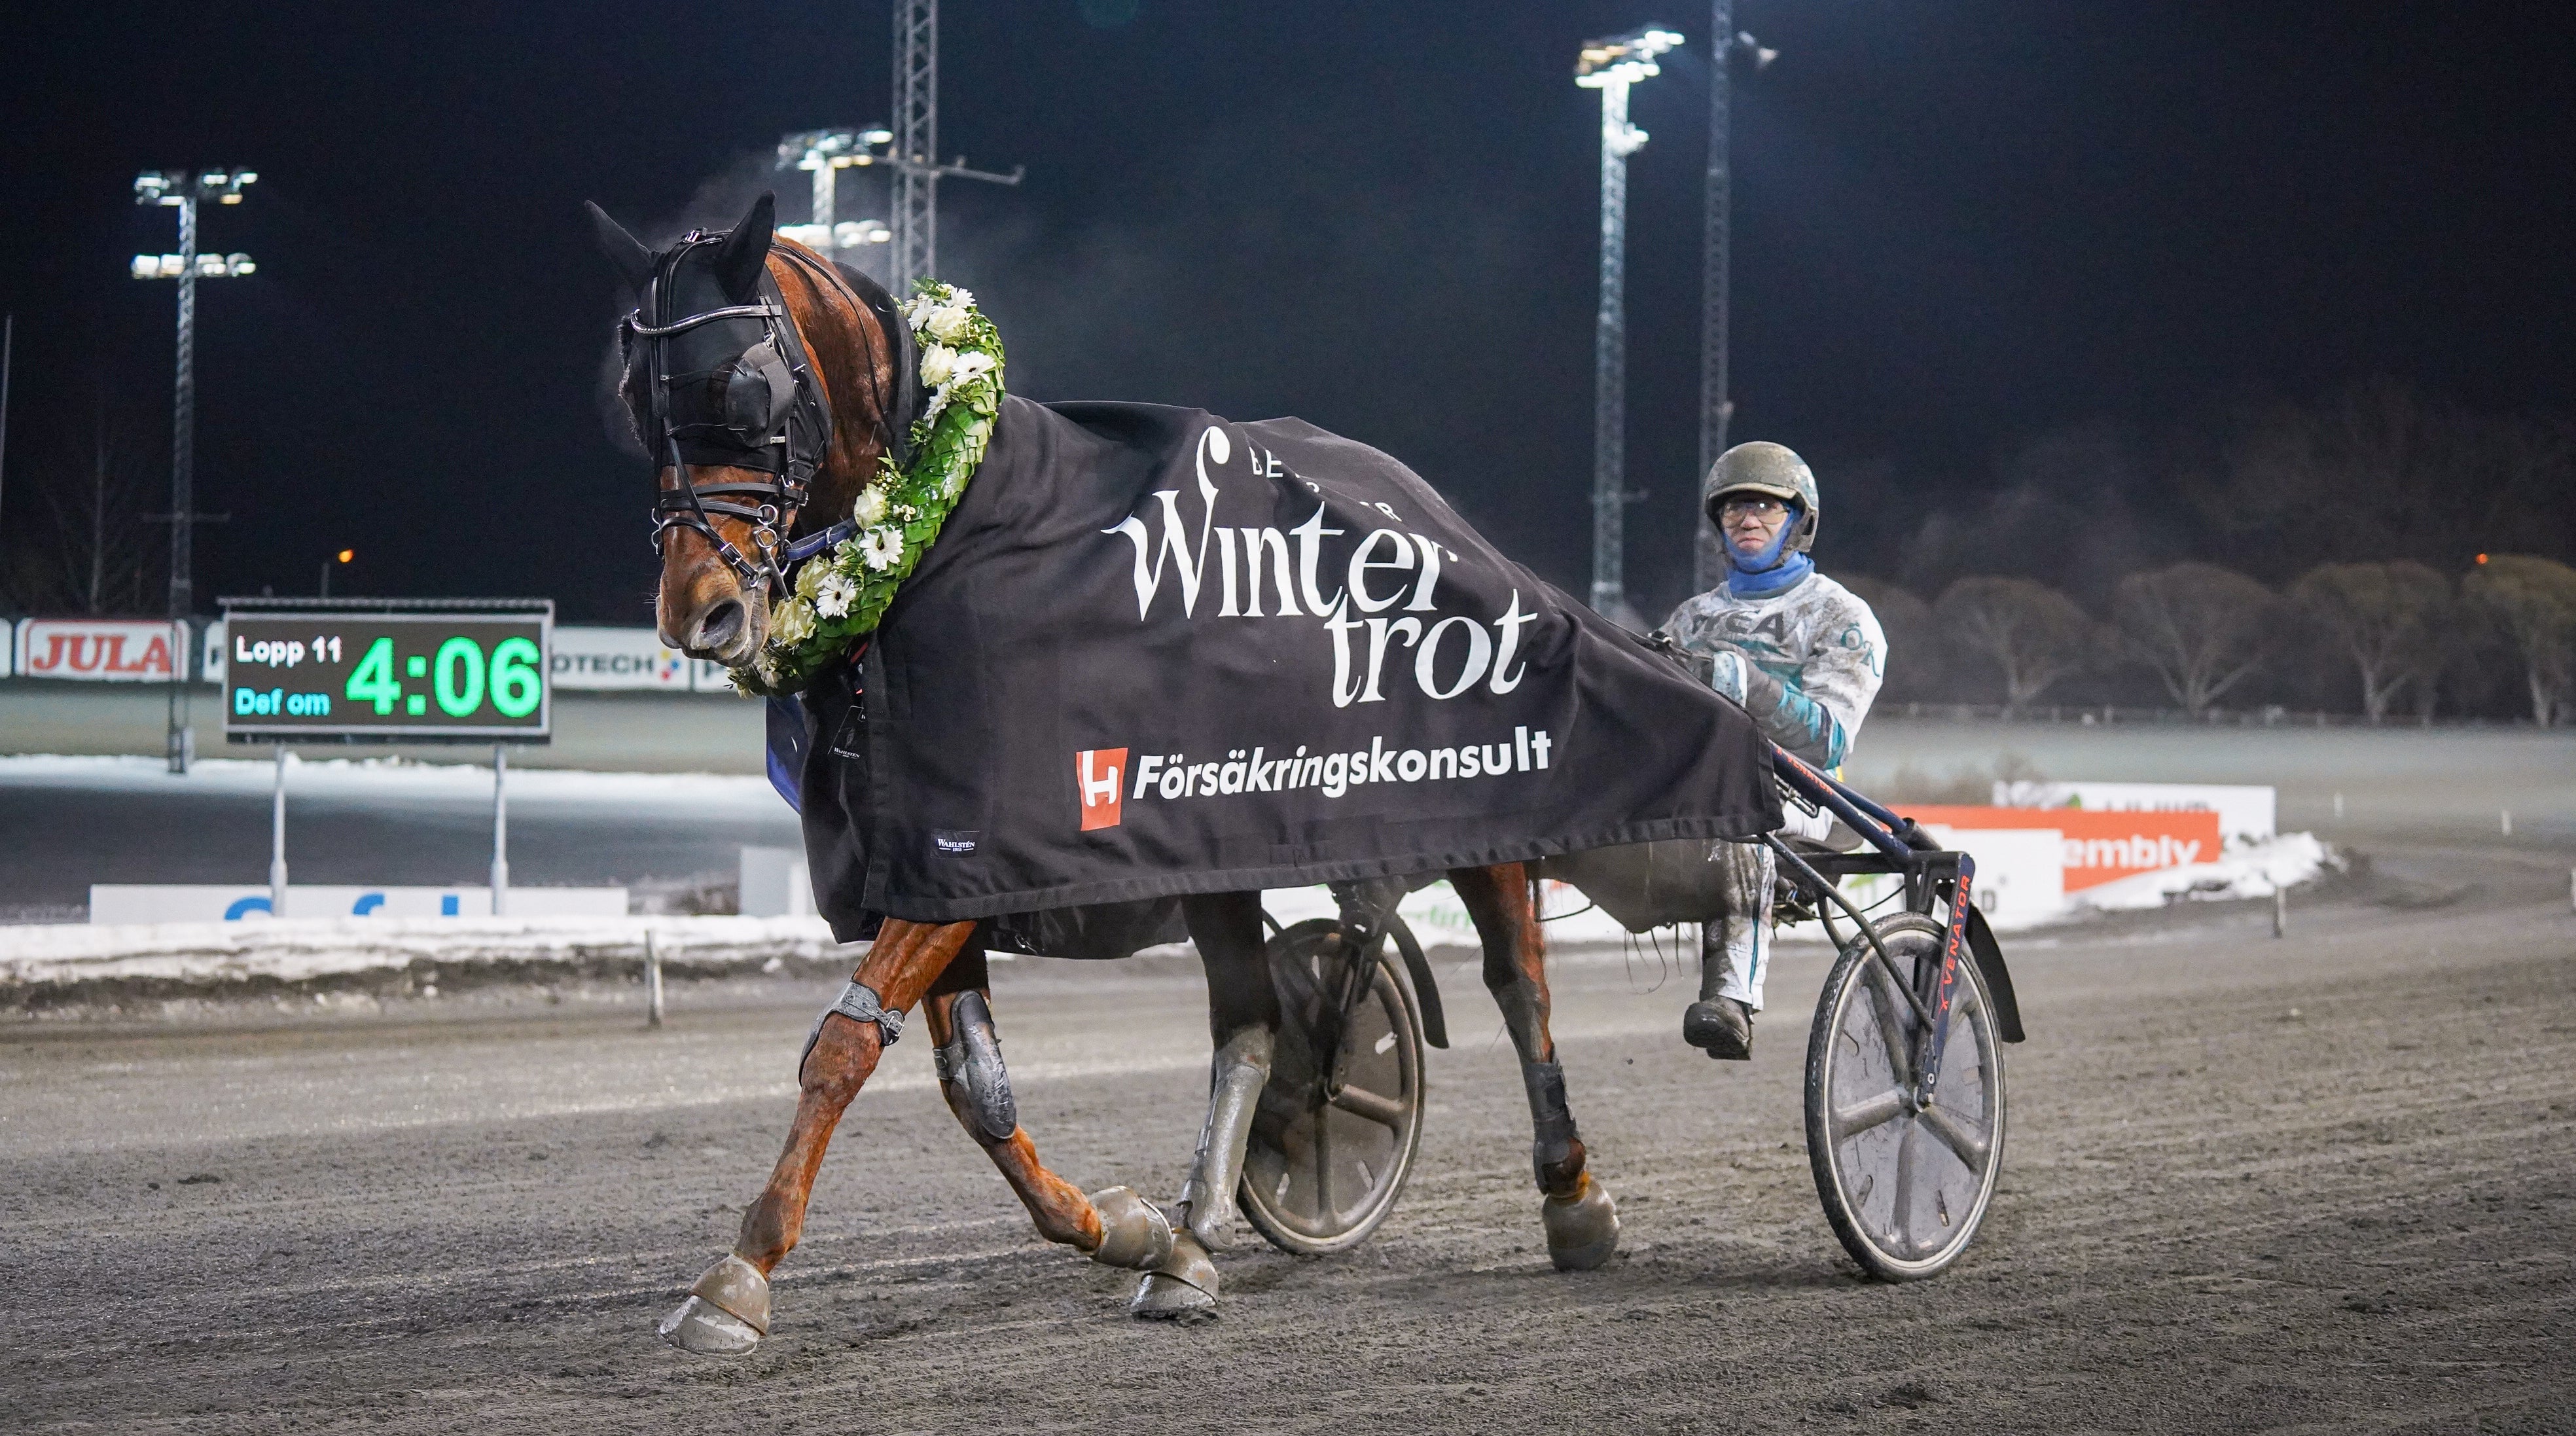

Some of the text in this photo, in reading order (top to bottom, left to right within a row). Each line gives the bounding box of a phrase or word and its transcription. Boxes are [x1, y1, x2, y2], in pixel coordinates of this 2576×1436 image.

[1101, 426, 1458, 621] Winter
[33, 634, 171, 672] JULA
[236, 635, 305, 668] Lopp
[312, 636, 342, 663] 11
[345, 636, 543, 718] 4:06
[1323, 588, 1538, 708] trot
[234, 687, 331, 716] Def om
[1132, 725, 1552, 799] Försäkringskonsult
[1943, 875, 1970, 984] VENATOR
